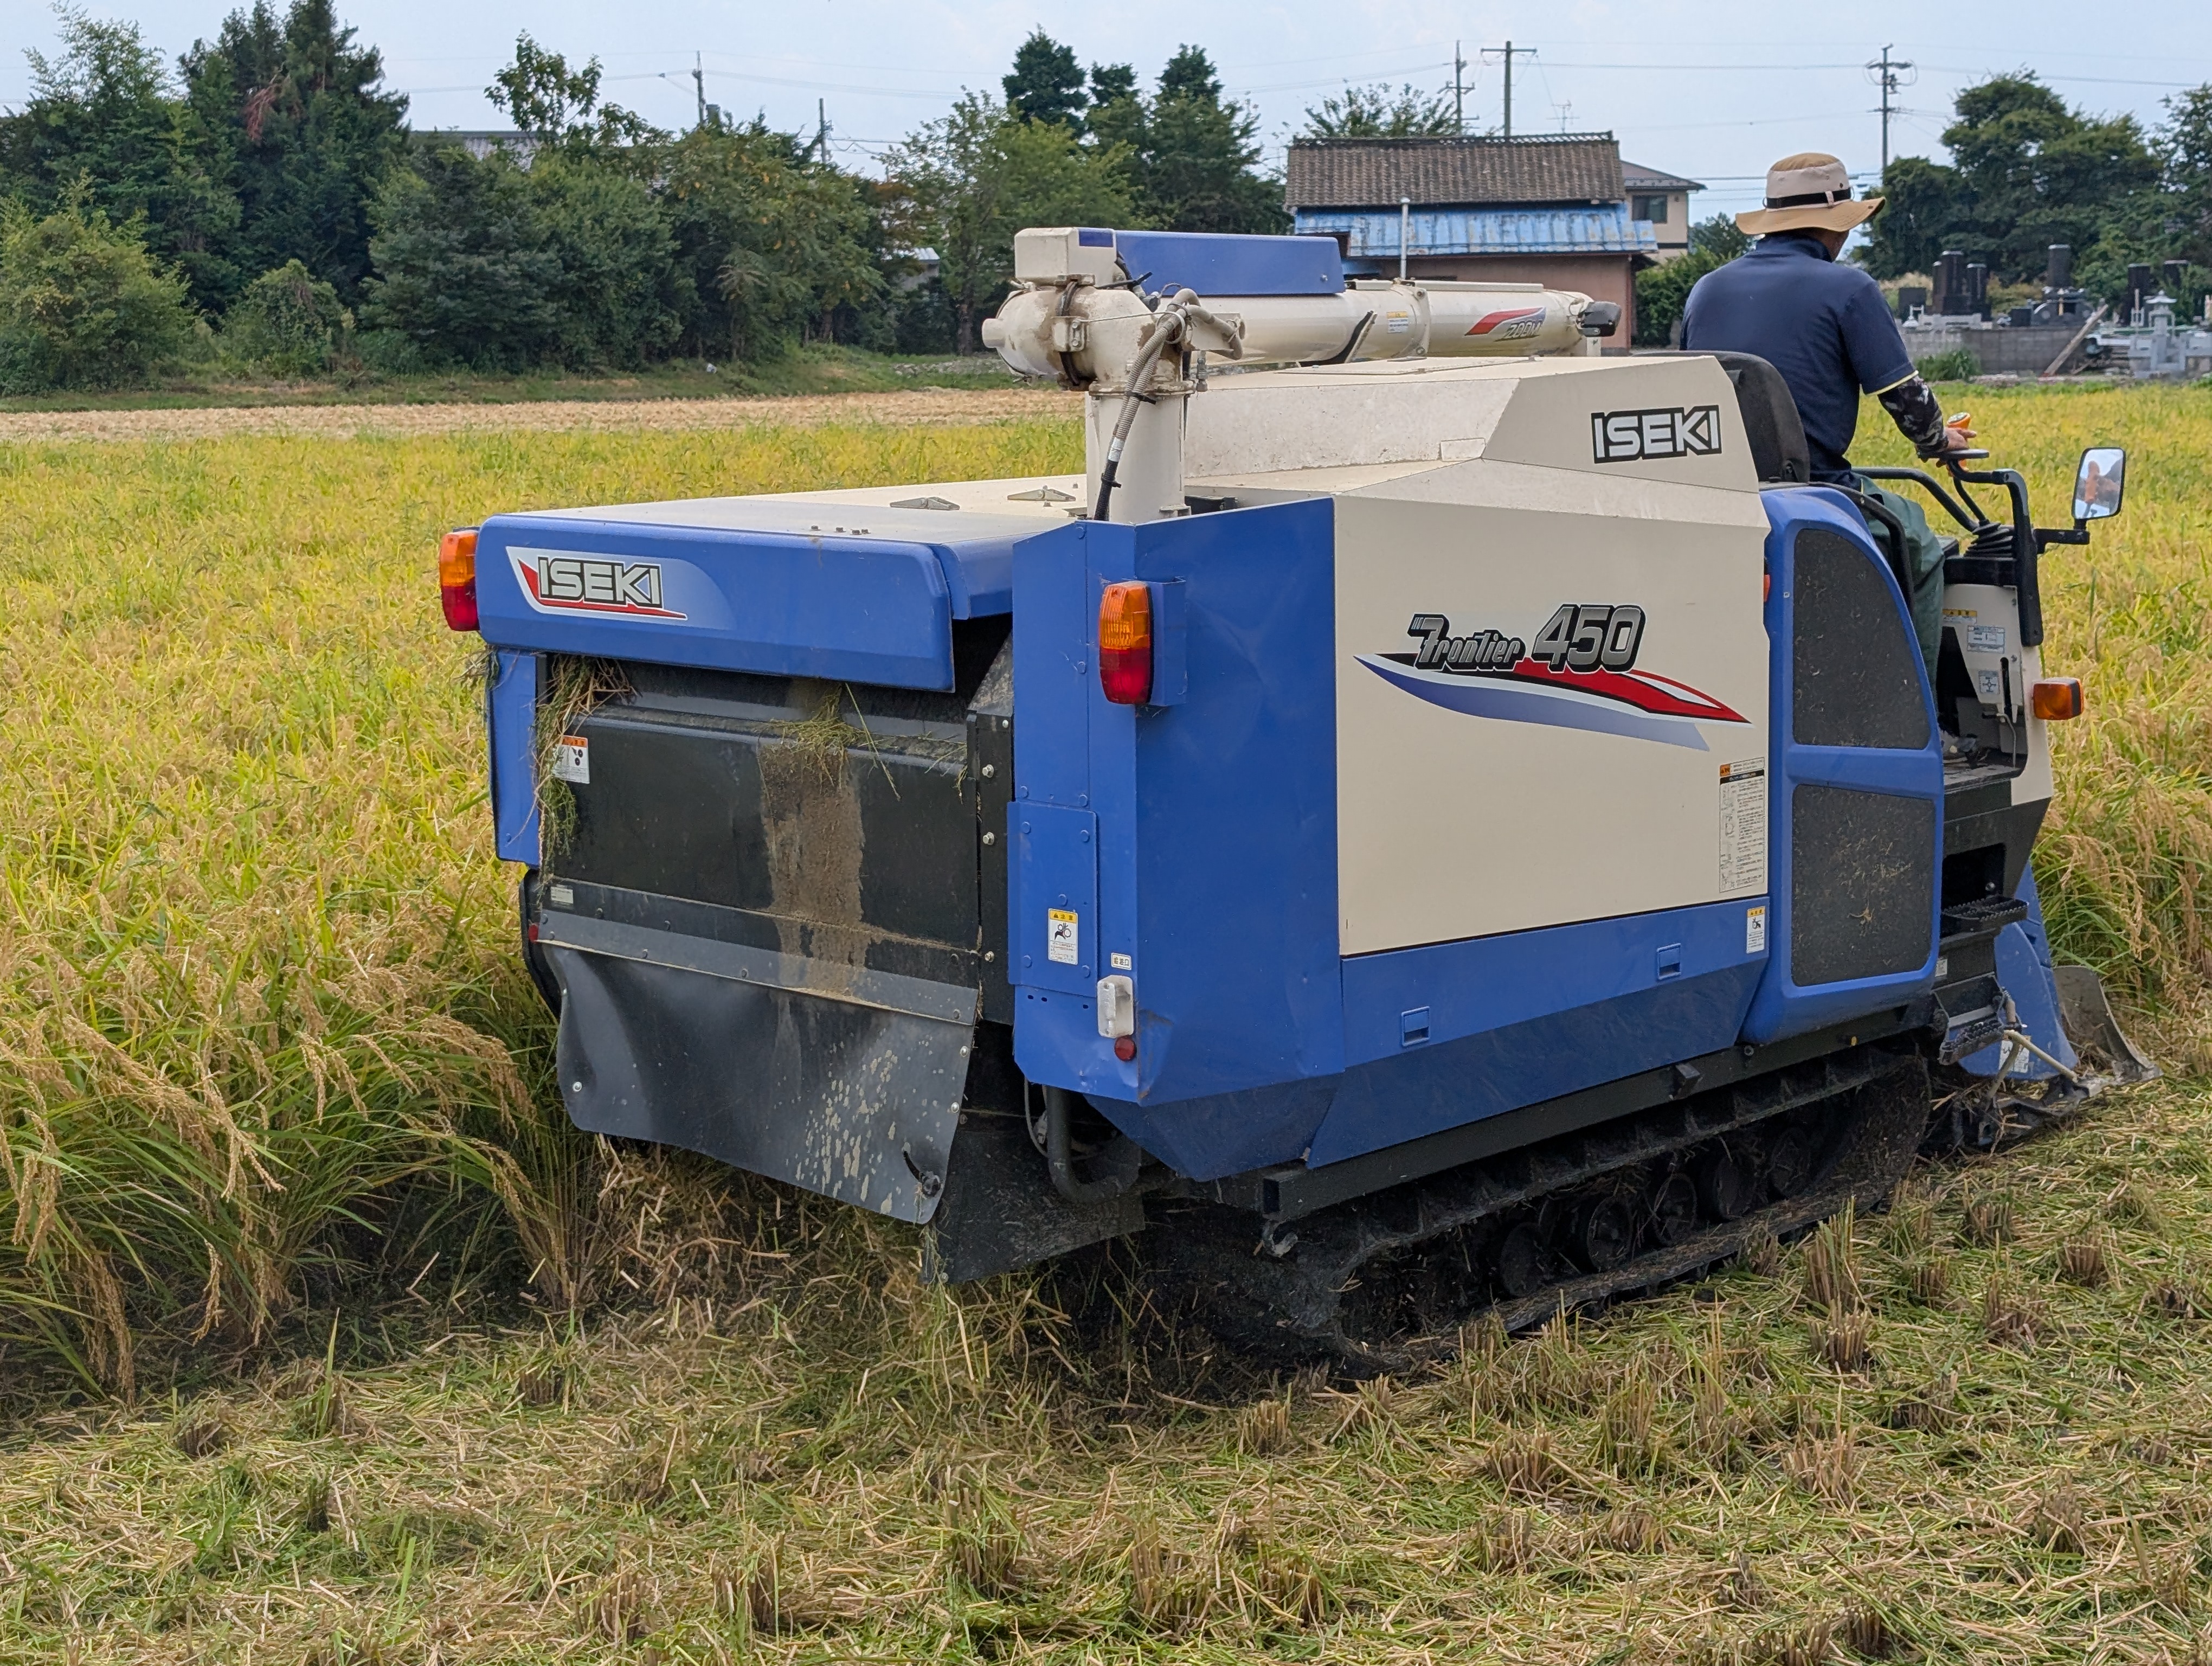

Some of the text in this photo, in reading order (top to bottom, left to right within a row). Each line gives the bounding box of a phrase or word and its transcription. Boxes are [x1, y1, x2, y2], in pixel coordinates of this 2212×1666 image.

[1503, 320, 1542, 339] ZOOM
[1591, 405, 1721, 463] ISEKI
[538, 557, 663, 608] ISEKI
[1407, 604, 1647, 672] Frontier 450
